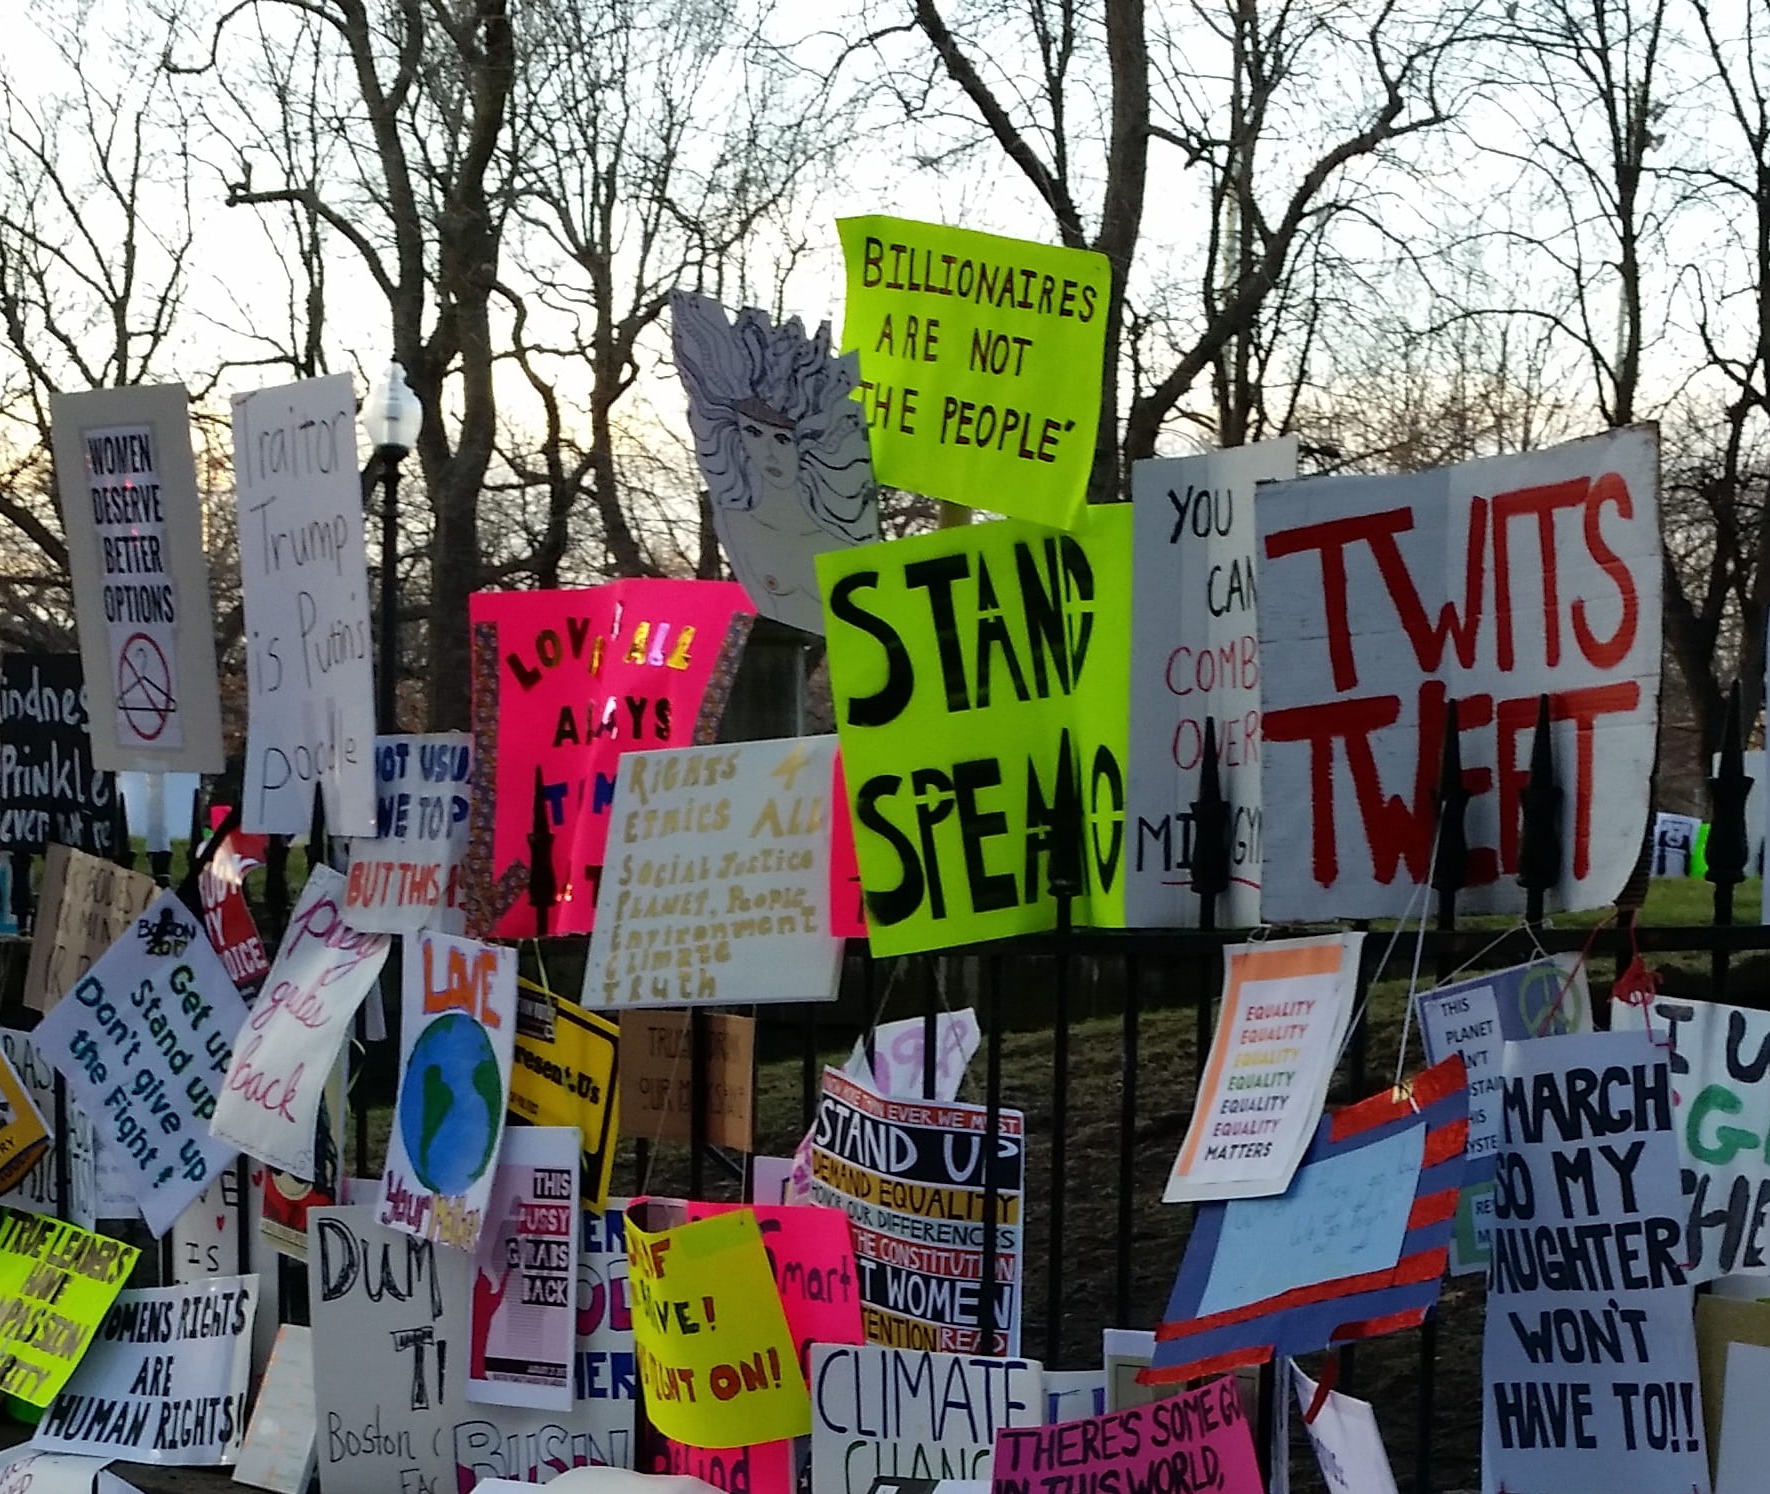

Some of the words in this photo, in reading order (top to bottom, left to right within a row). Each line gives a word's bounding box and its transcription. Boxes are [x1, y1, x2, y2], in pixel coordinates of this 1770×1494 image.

[863, 236, 1097, 323] BILLIONAIRES
[876, 313, 940, 362] ARE
[969, 328, 1032, 376] NOT
[859, 381, 919, 435] THE
[87, 434, 152, 477] WOMEN
[92, 484, 164, 527] DESERVE
[1168, 484, 1233, 543] YOU
[102, 535, 163, 577] BETTER
[247, 502, 348, 577] Trump
[105, 584, 175, 625] OPTIONS
[1265, 472, 1637, 691] TWITS
[830, 535, 1094, 727] STAND
[252, 631, 284, 697] is
[346, 861, 394, 908] BUT
[397, 863, 441, 907] THIS
[168, 965, 213, 1031] Get
[1246, 1001, 1314, 1022] EQUALITY
[1441, 999, 1470, 1016] THIS
[69, 1028, 107, 1085] the
[130, 978, 193, 1076] Stand
[186, 1077, 217, 1120] up
[1234, 1047, 1302, 1068] EQUALITY
[1240, 1024, 1308, 1045] EQUALITY
[1446, 1020, 1494, 1045] PLANET
[75, 976, 141, 1066] Don't
[131, 1069, 181, 1135] give
[180, 1138, 206, 1183] up
[1220, 1095, 1290, 1114] EQUALITY
[1227, 1071, 1296, 1092] EQUALITY
[815, 1098, 918, 1173] STAND
[1204, 1141, 1273, 1161] MATTERS
[1213, 1118, 1281, 1137] EQUALITY
[535, 1172, 570, 1196] THIS
[813, 1151, 872, 1198] DEMAND
[1495, 1147, 1533, 1221] SO
[1554, 1139, 1645, 1212] MY
[129, 1355, 175, 1397] ARE
[817, 1348, 1031, 1445] CLIMATE
[42, 1393, 152, 1447] HUMAN
[325, 1412, 415, 1464] Boston
[1149, 1386, 1218, 1448] SOME
[1494, 1382, 1597, 1450] HAVE
